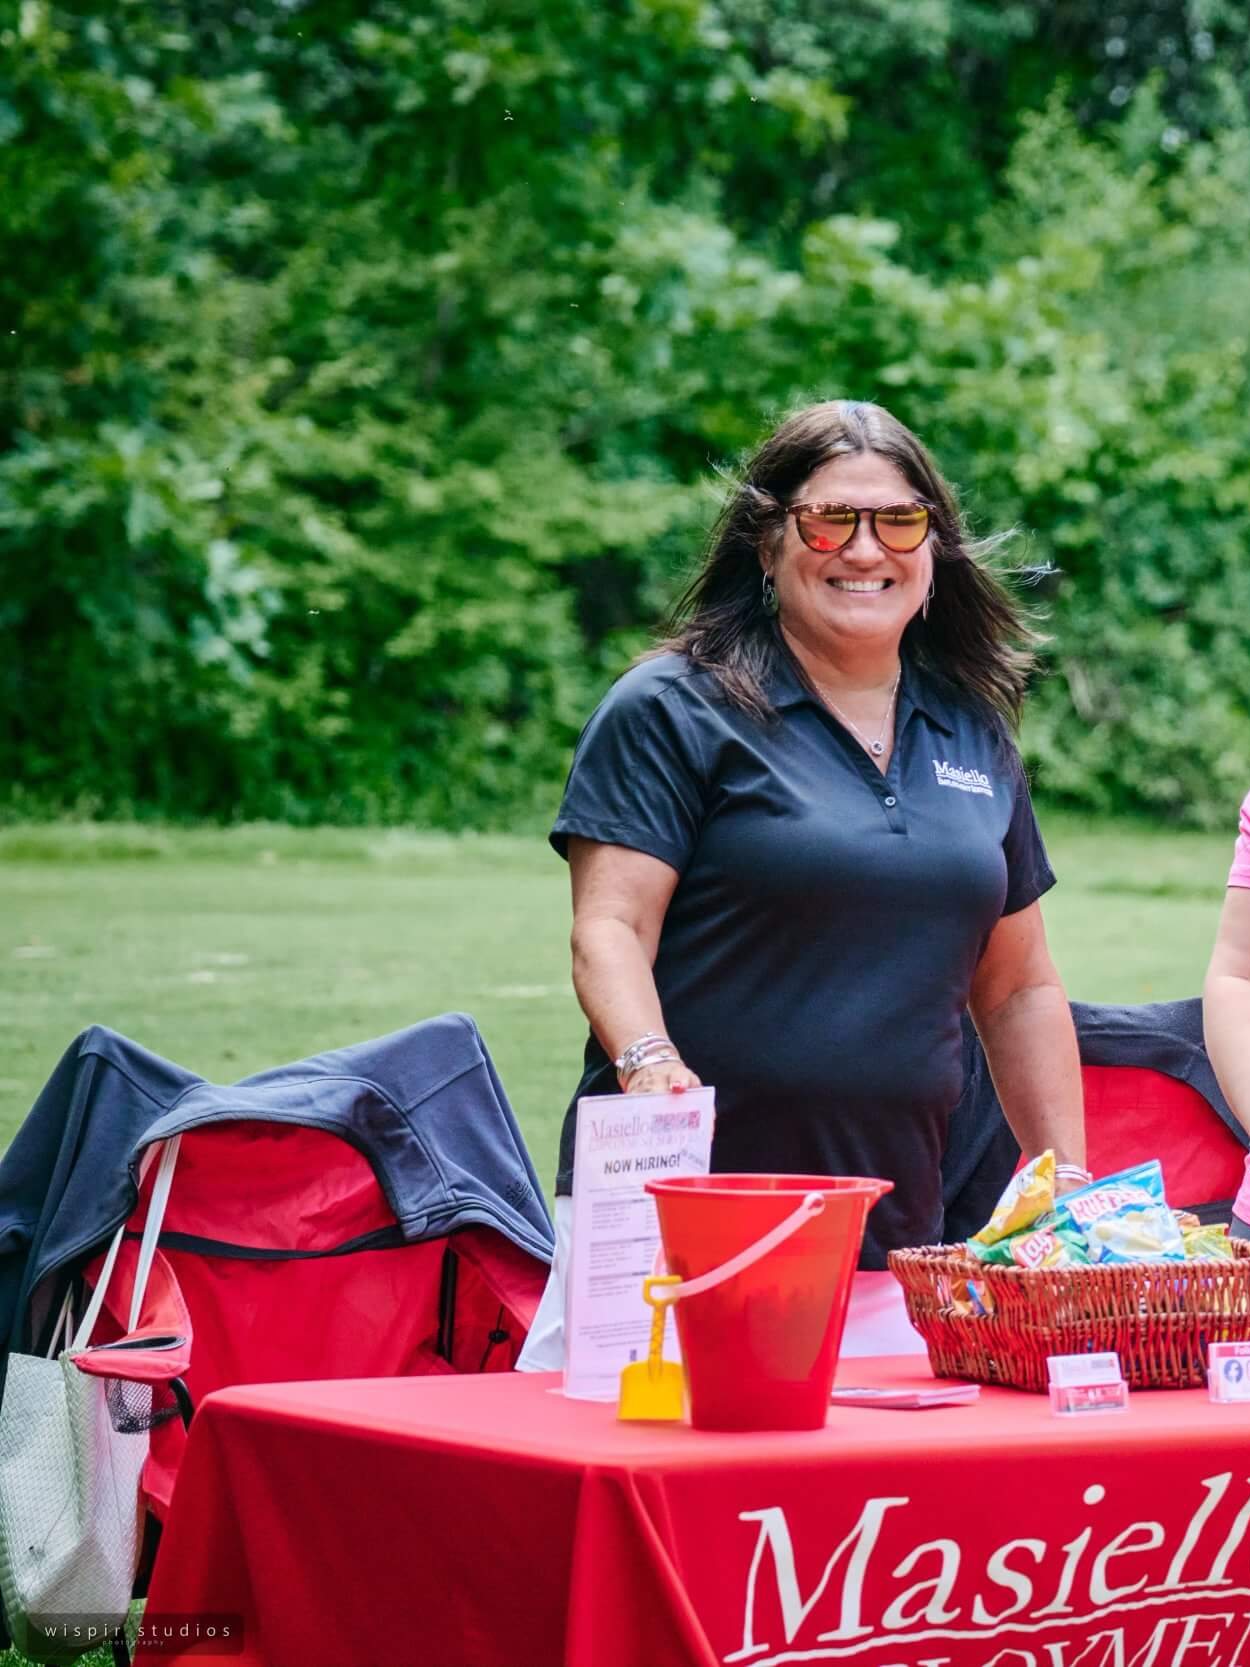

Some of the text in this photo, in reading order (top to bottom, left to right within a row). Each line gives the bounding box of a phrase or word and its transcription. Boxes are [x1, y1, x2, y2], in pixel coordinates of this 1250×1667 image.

[932, 759, 989, 785] Masiello
[603, 1159, 632, 1175] NOW
[634, 1153, 681, 1172] HIRING!
